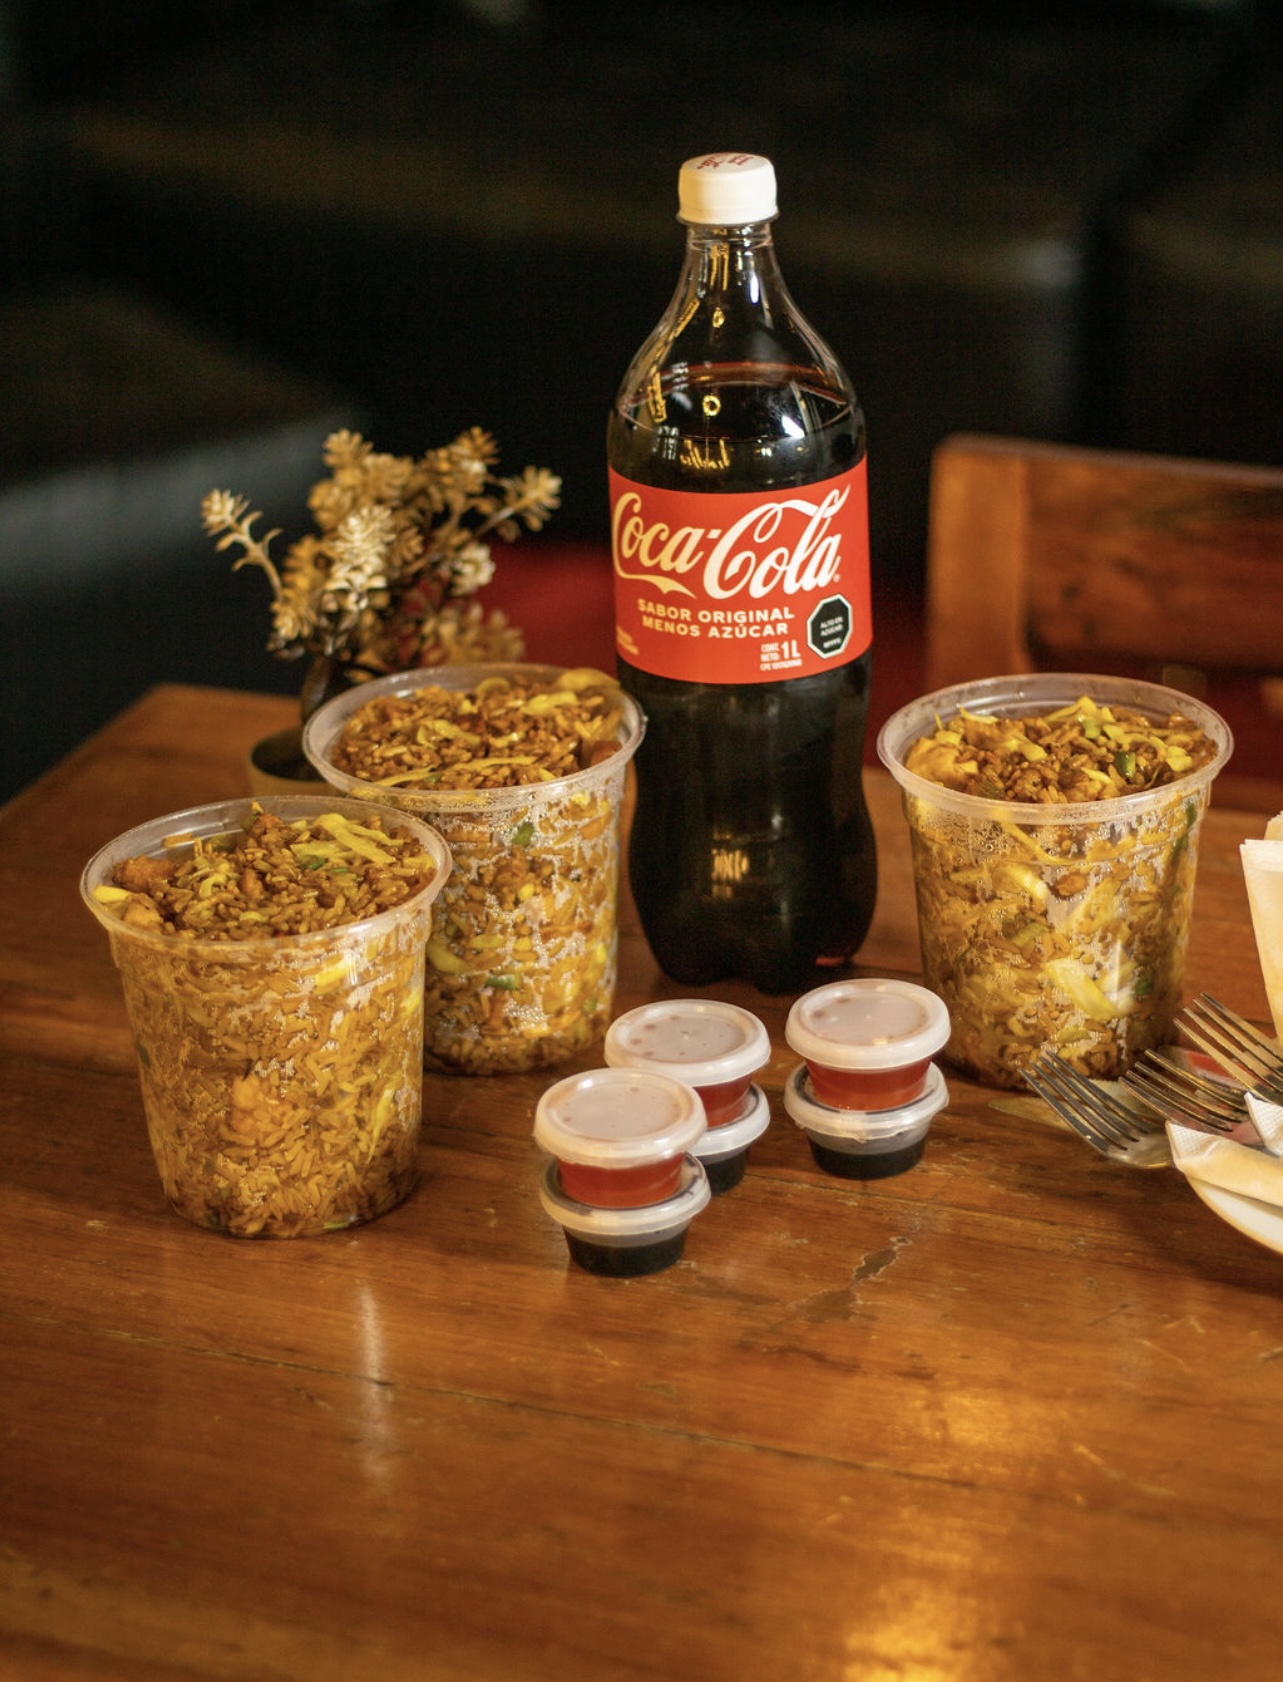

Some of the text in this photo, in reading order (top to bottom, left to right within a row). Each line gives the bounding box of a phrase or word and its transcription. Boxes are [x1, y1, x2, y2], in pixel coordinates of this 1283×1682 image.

[613, 484, 850, 600] Coca-Cola
[637, 599, 795, 624] SABOR ORIGINAL
[642, 615, 788, 638] MENOS AZÚCAR
